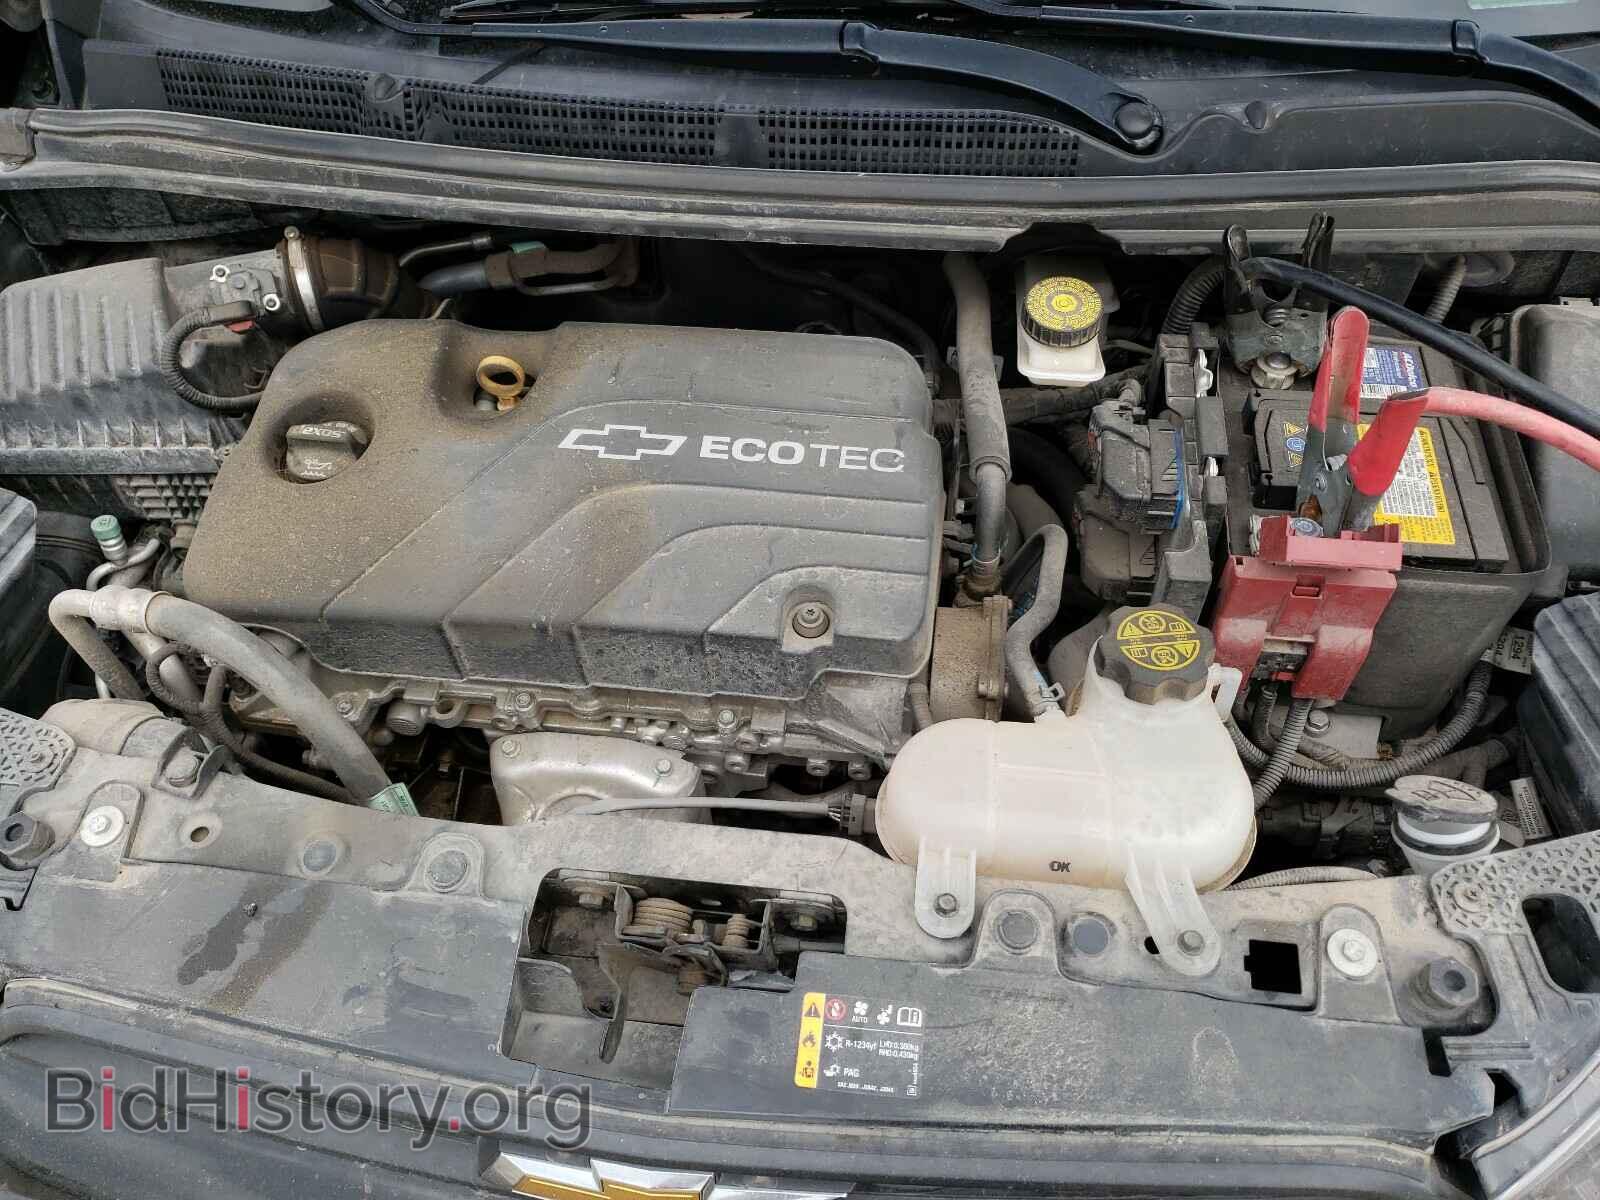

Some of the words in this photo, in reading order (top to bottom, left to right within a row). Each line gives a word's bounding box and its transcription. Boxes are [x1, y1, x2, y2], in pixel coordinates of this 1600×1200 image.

[699, 435, 905, 473] ECOTEC
[1049, 860, 1071, 873] OK
[851, 1015, 868, 1024] AUTO
[843, 1067, 860, 1078] PAG
